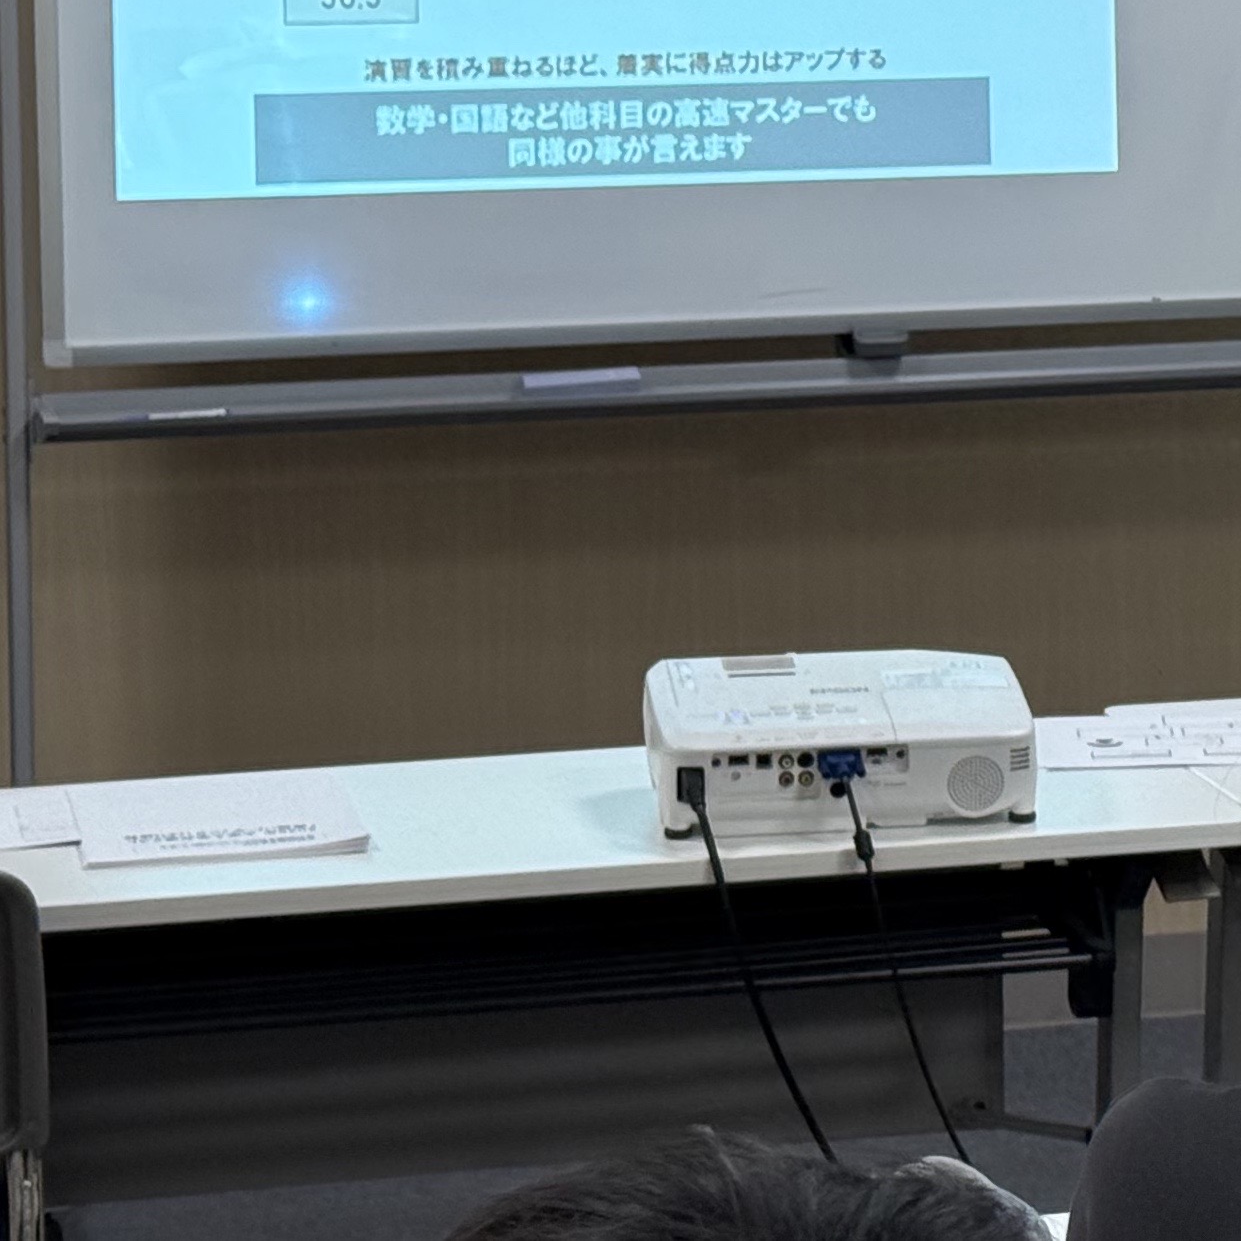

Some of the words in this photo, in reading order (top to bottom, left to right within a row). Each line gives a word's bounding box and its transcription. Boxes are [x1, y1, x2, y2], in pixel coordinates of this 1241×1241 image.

[507, 132, 754, 168] 同様の事が言えます
